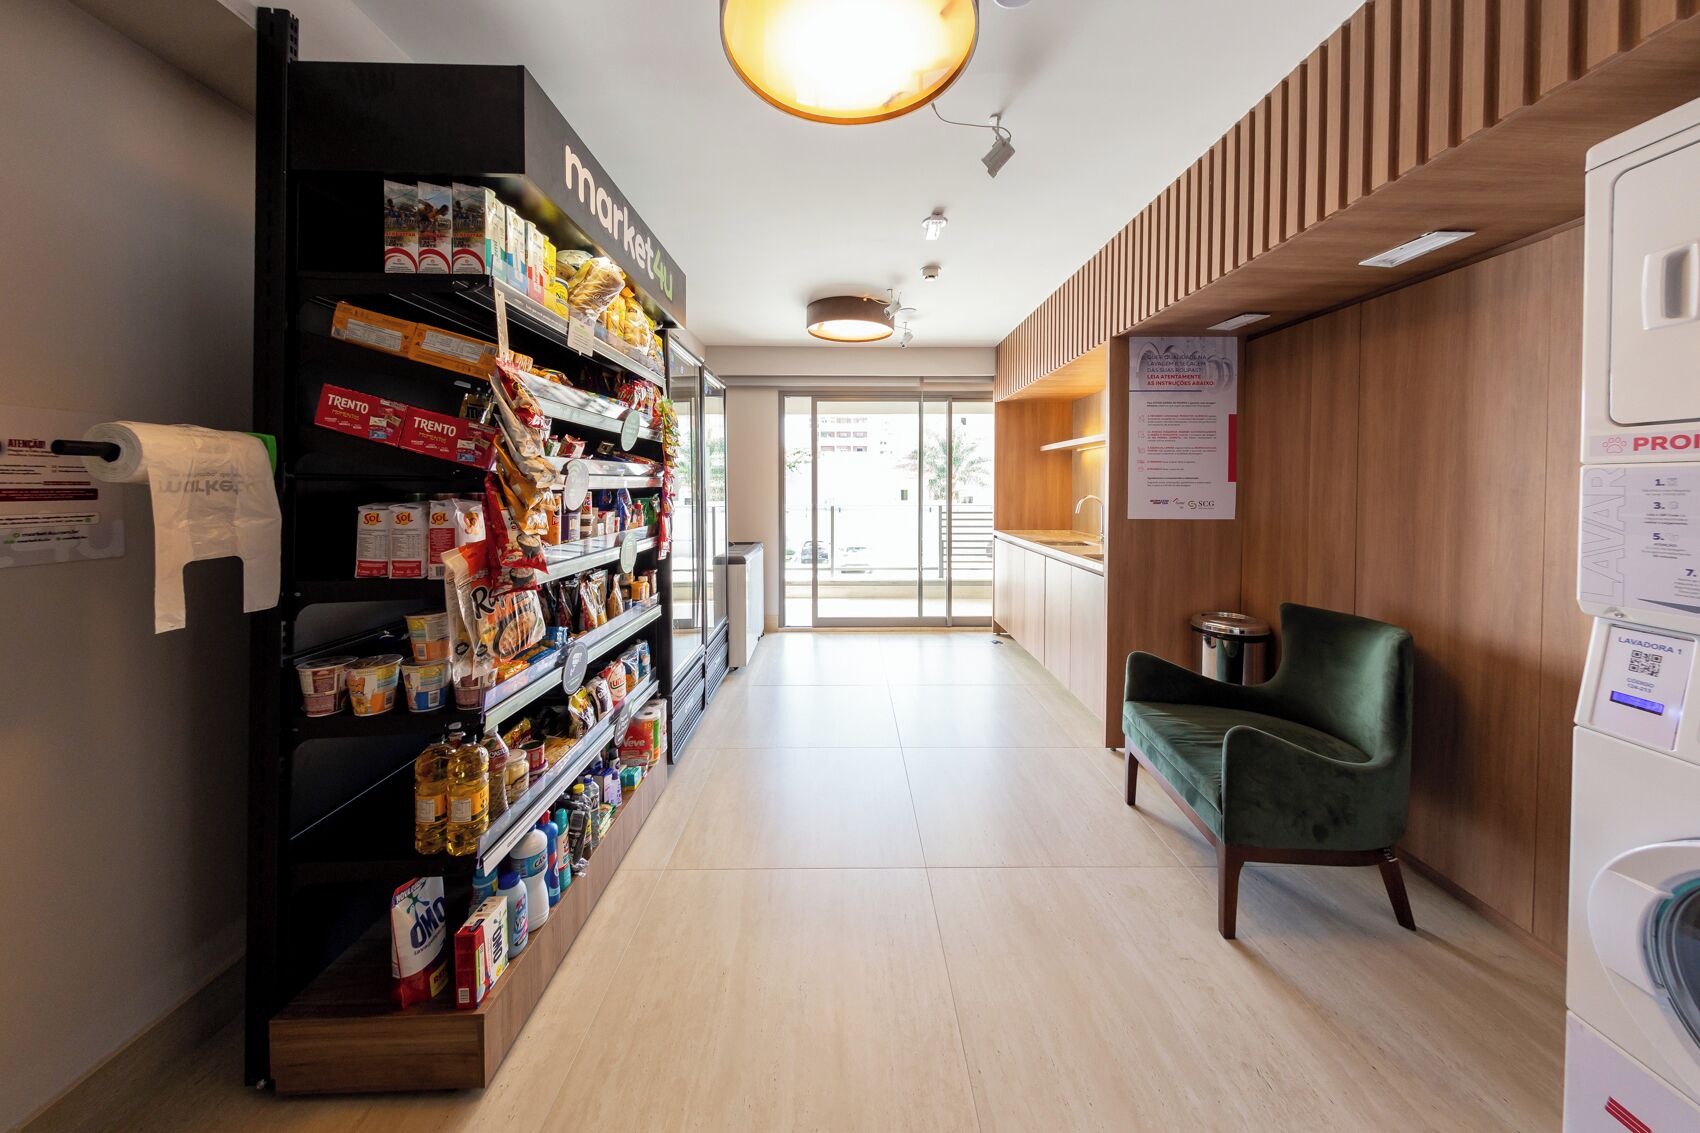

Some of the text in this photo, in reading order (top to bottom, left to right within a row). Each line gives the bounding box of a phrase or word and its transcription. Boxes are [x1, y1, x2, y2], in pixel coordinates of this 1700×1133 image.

[565, 144, 673, 301] market4u
[328, 393, 369, 414] TRENTO
[414, 416, 456, 437] TRENTO
[1655, 478, 1664, 486] 1.
[1653, 502, 1665, 510] 3.
[1652, 532, 1664, 540] 5.
[1685, 568, 1696, 577] 7.
[1618, 636, 1674, 654] LAVADORA
[410, 896, 446, 950] OMO
[492, 925, 503, 964] OMO
